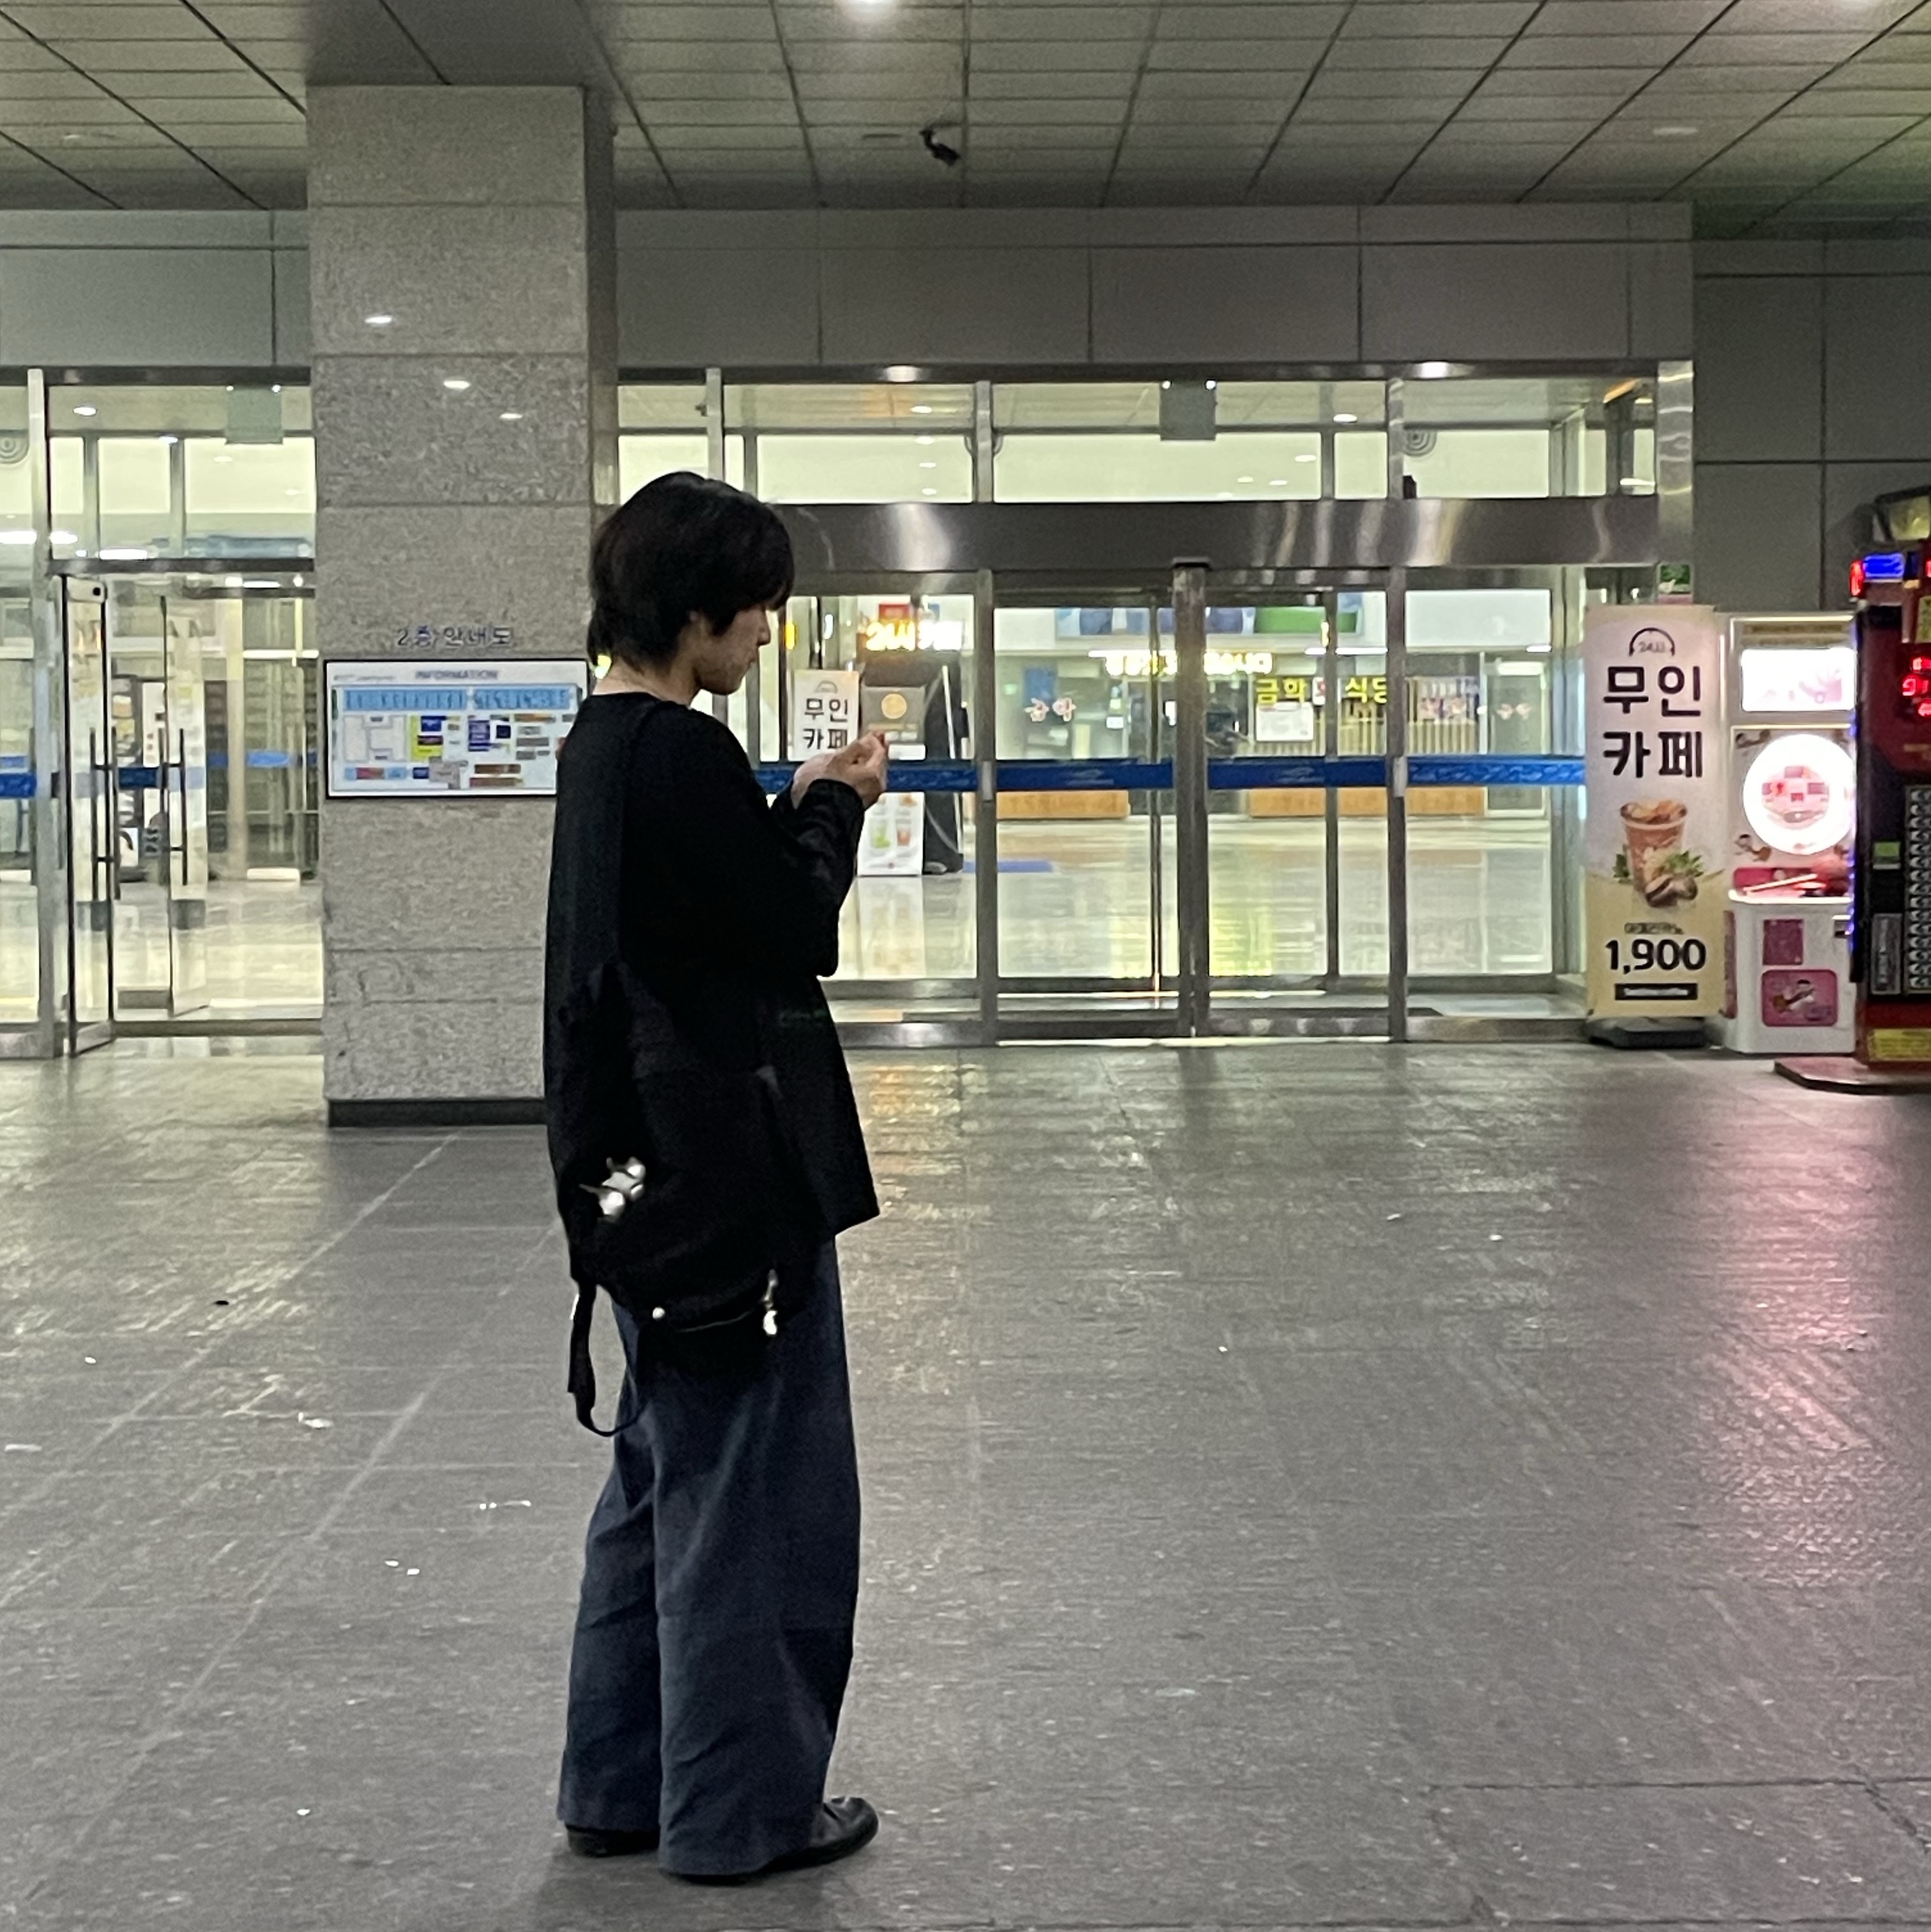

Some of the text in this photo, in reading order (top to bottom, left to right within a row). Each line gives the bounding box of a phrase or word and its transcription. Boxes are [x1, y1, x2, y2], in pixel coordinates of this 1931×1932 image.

[804, 698, 848, 722] 무인
[1603, 666, 1701, 717] 무인
[803, 727, 848, 750] 카페
[1603, 731, 1703, 778] 카페
[1605, 938, 1707, 975] 1,900
